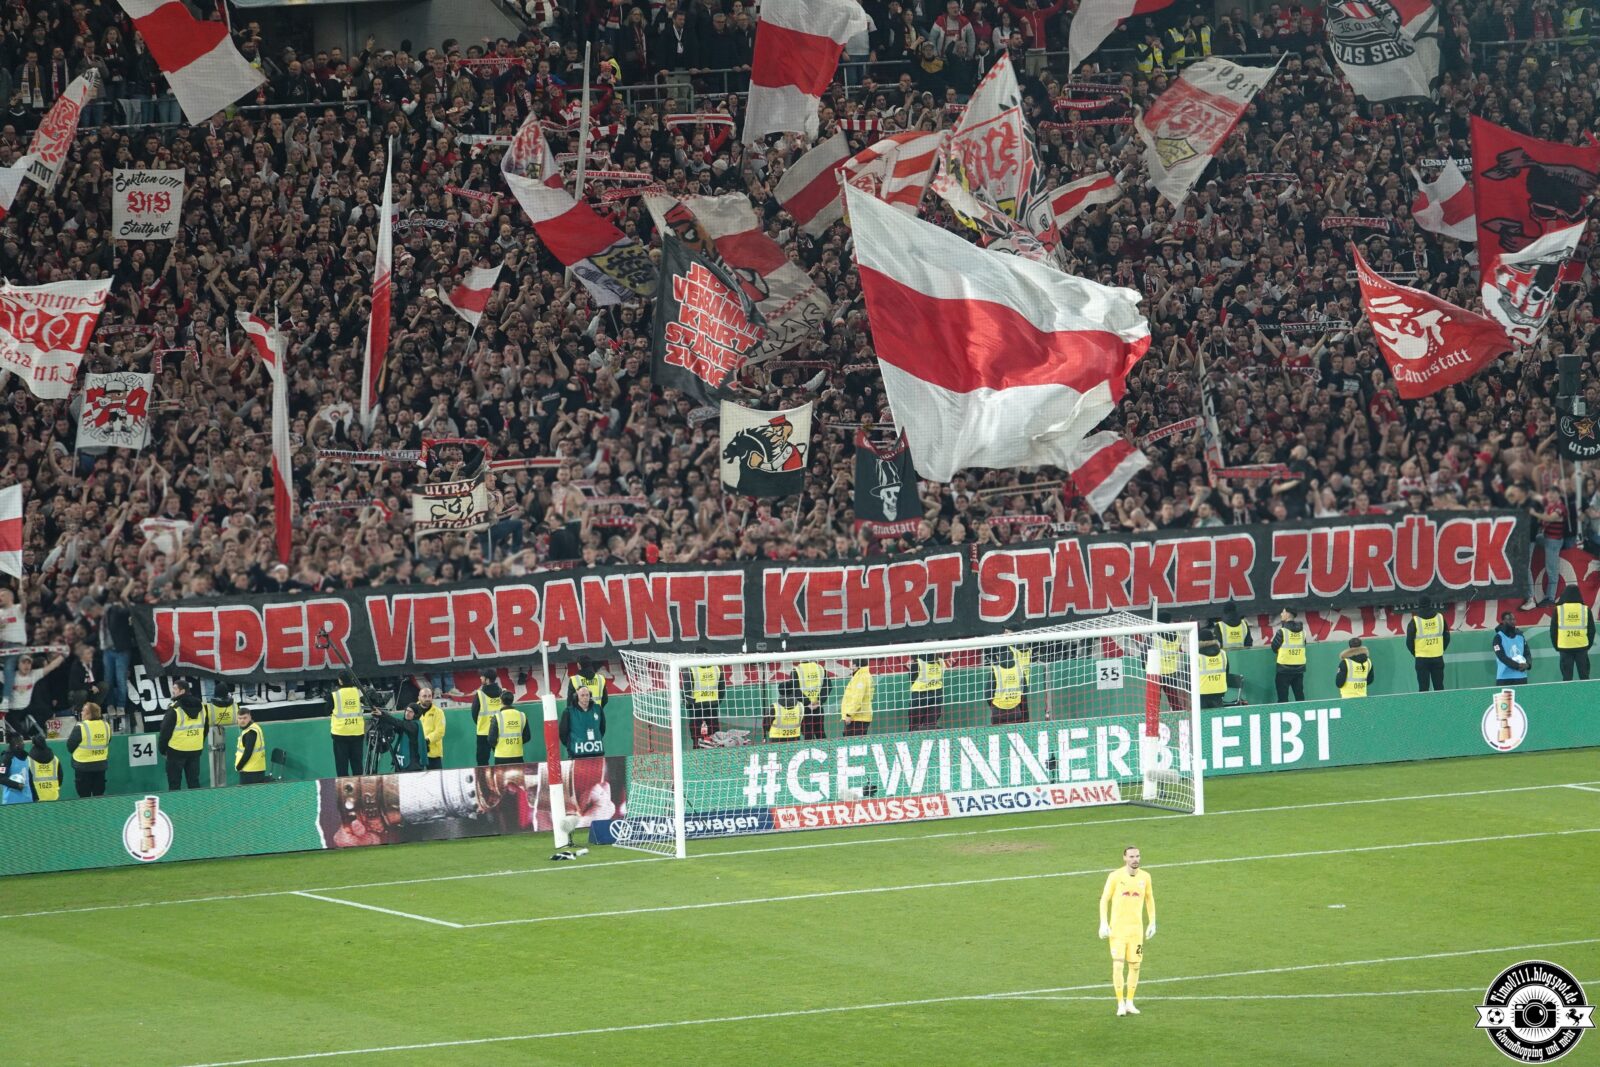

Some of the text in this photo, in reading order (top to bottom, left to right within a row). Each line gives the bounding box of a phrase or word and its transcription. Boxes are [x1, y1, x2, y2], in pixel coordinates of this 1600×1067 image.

[120, 219, 173, 237] Stuttgart
[424, 480, 476, 495] ULTRAS
[152, 515, 1517, 675] JEDER VERBANNTE KEHRT STÄRKER ZURÜCK
[1100, 667, 1120, 681] 35
[132, 743, 154, 758] 34
[575, 741, 603, 754] HOST
[801, 797, 920, 828] STRAUSS
[641, 813, 759, 835] Volswagen
